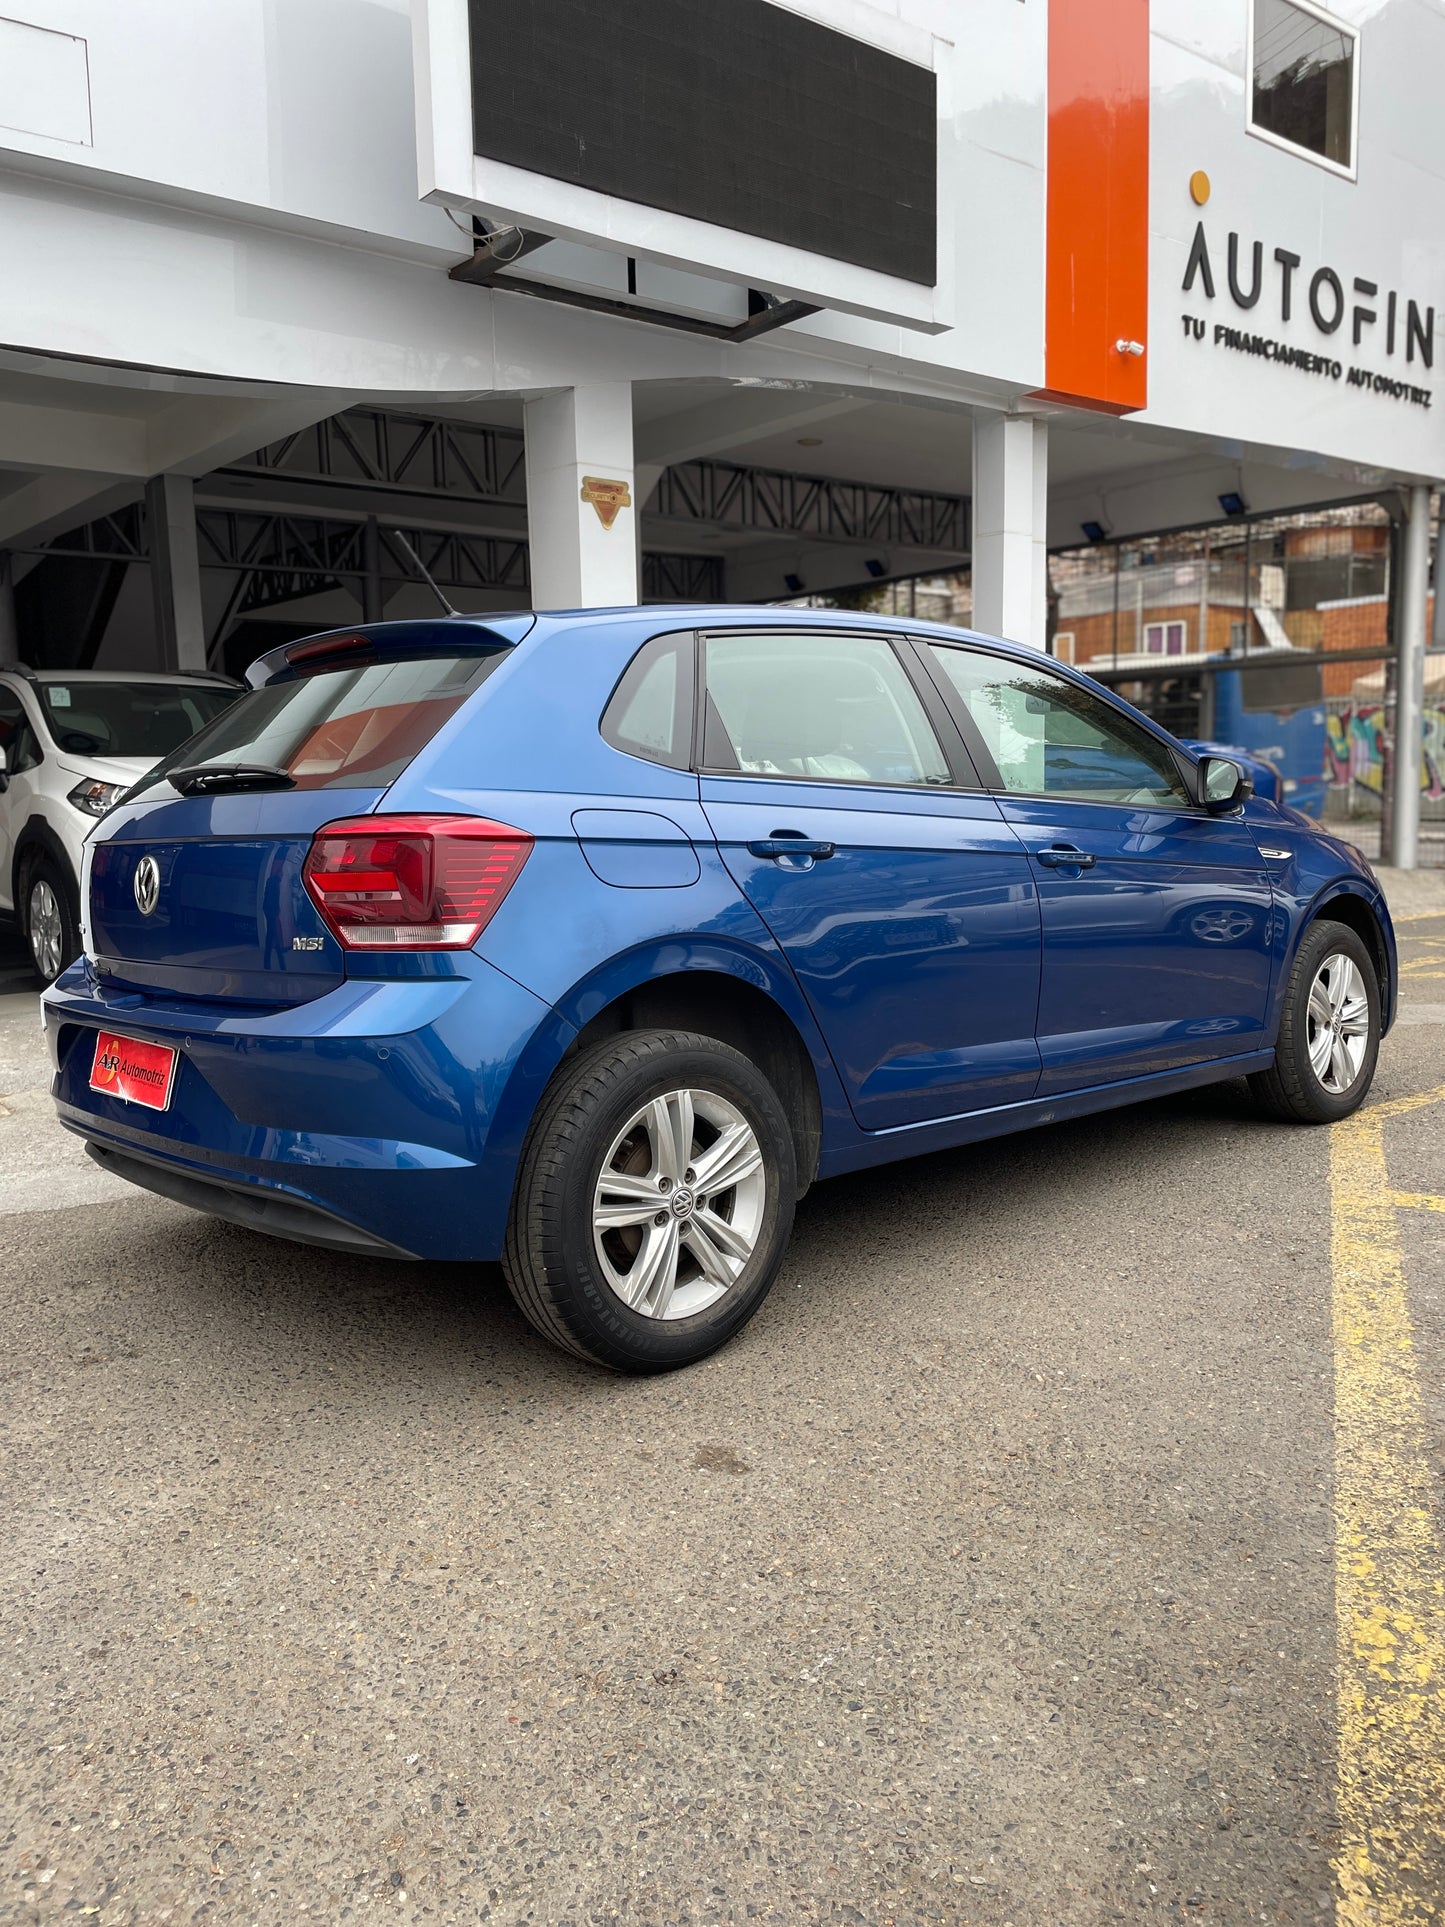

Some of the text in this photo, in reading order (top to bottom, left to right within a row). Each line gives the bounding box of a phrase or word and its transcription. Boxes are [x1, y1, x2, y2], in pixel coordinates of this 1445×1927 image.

[1182, 220, 1434, 369] AUTOFIN
[1181, 314, 1432, 408] TU FINANCIAMIENTO AUTOMOTRIZ
[120, 1060, 166, 1086] Automotriz
